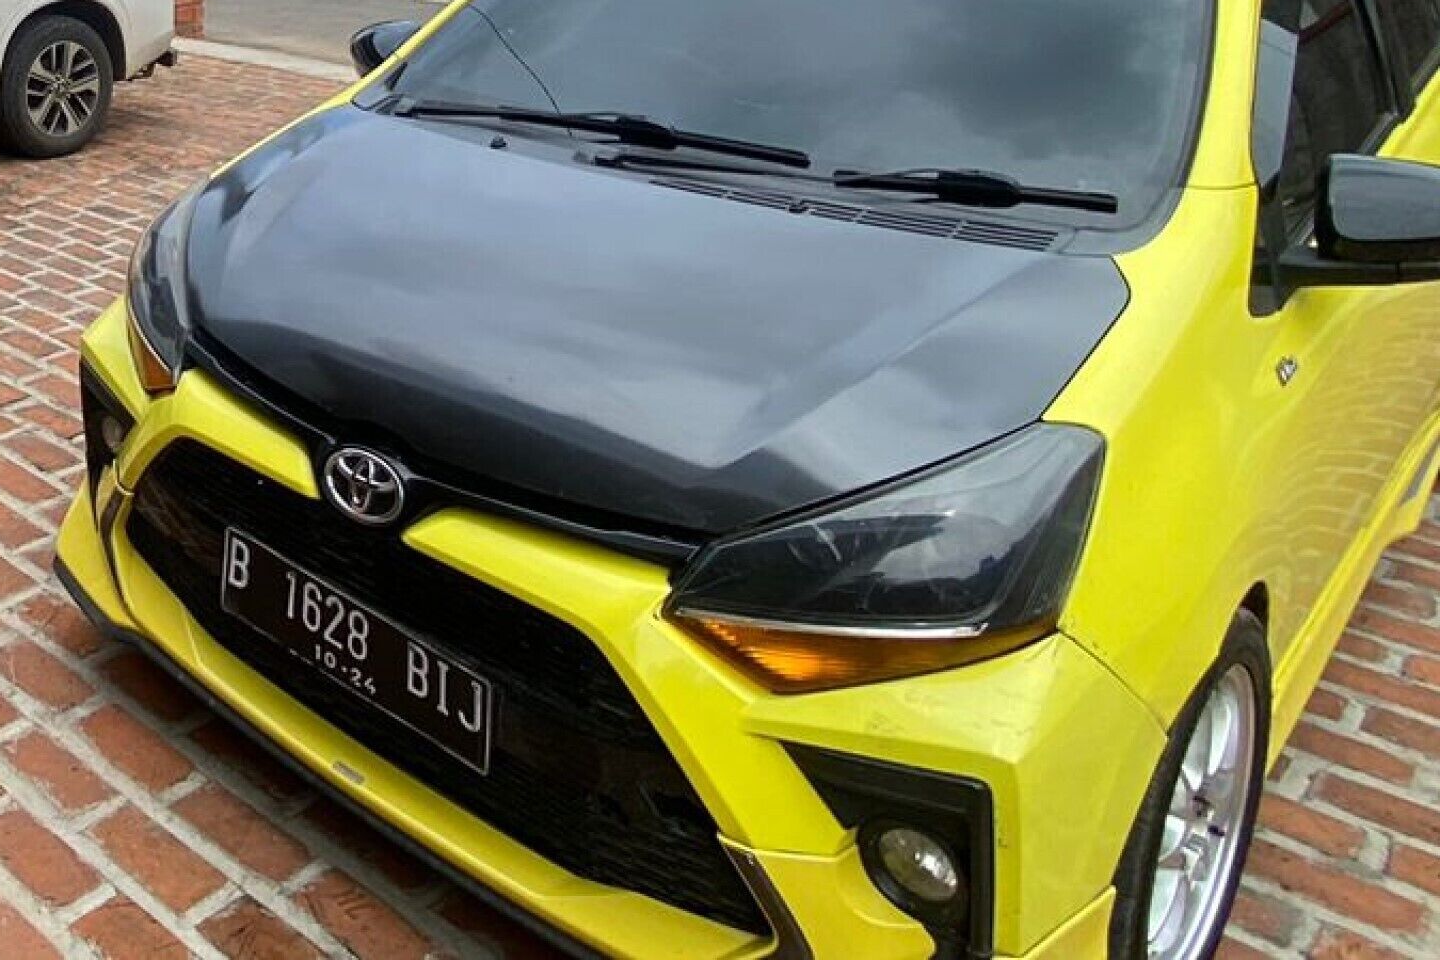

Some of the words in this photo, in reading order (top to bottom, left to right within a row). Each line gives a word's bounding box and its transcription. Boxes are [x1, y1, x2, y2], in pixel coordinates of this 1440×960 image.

[227, 536, 250, 588] B
[285, 570, 369, 660] 1628
[406, 639, 482, 732] BIJ
